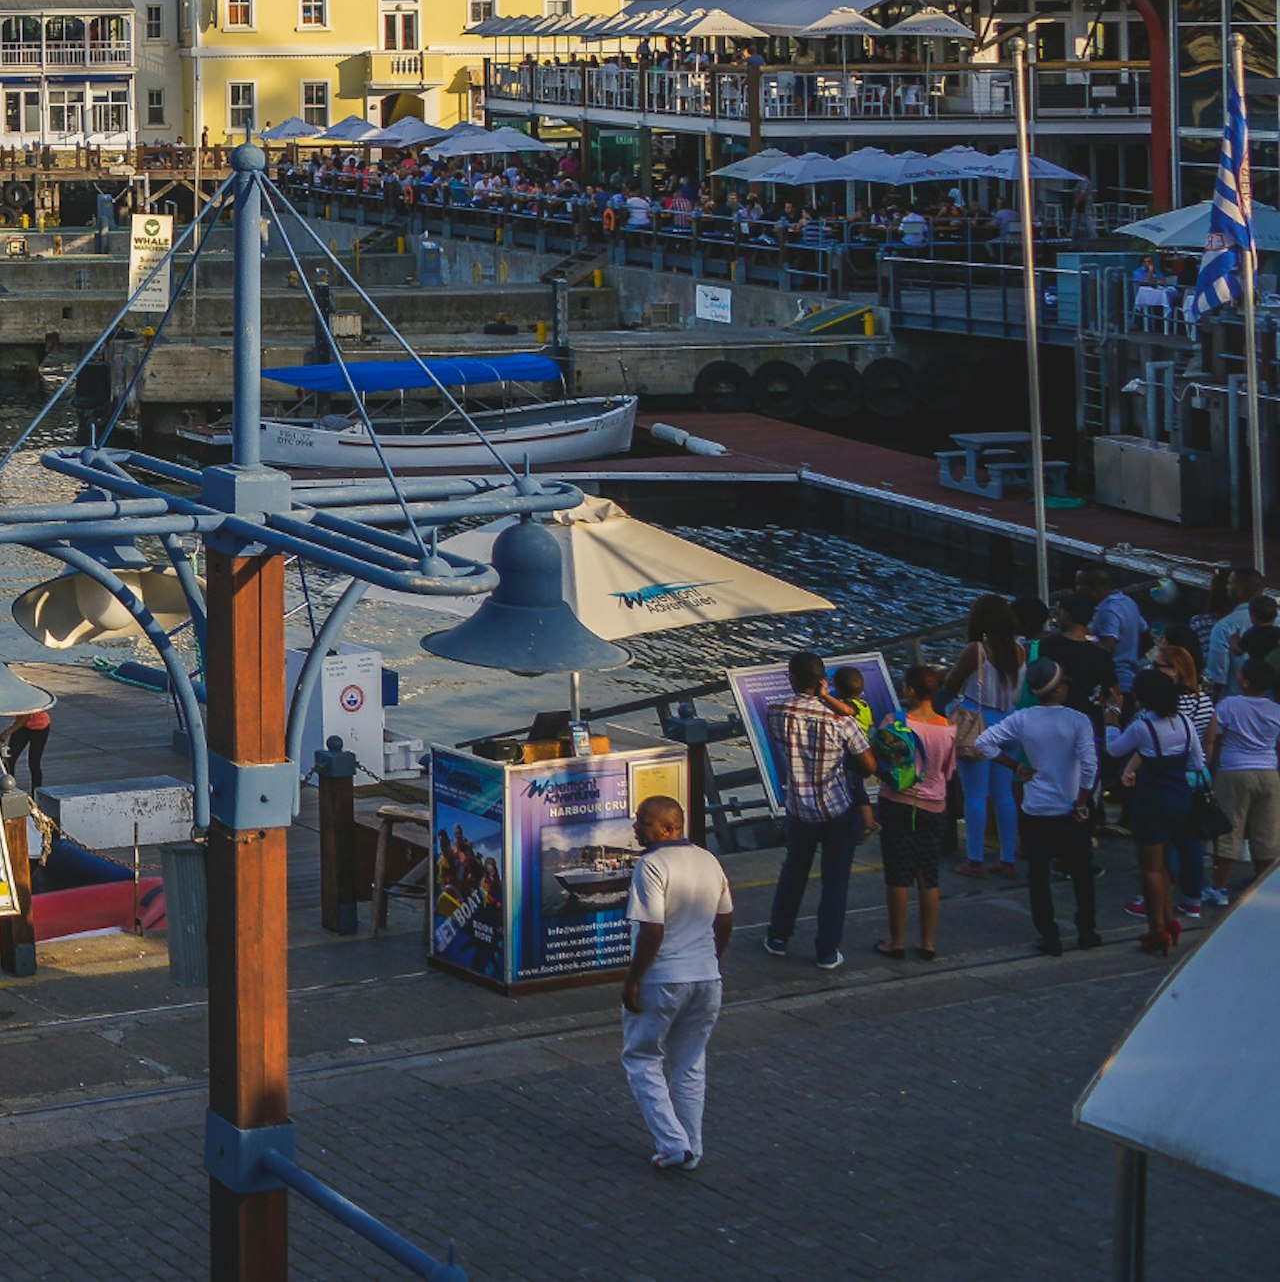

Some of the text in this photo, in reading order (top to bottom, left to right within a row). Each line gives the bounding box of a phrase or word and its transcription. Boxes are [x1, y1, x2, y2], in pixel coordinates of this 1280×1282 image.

[134, 237, 169, 246] WHALE
[646, 595, 717, 614] Adventures
[543, 788, 601, 805] Adventures
[549, 804, 603, 818] HARBOUR
[436, 888, 481, 952] JET BOAT
